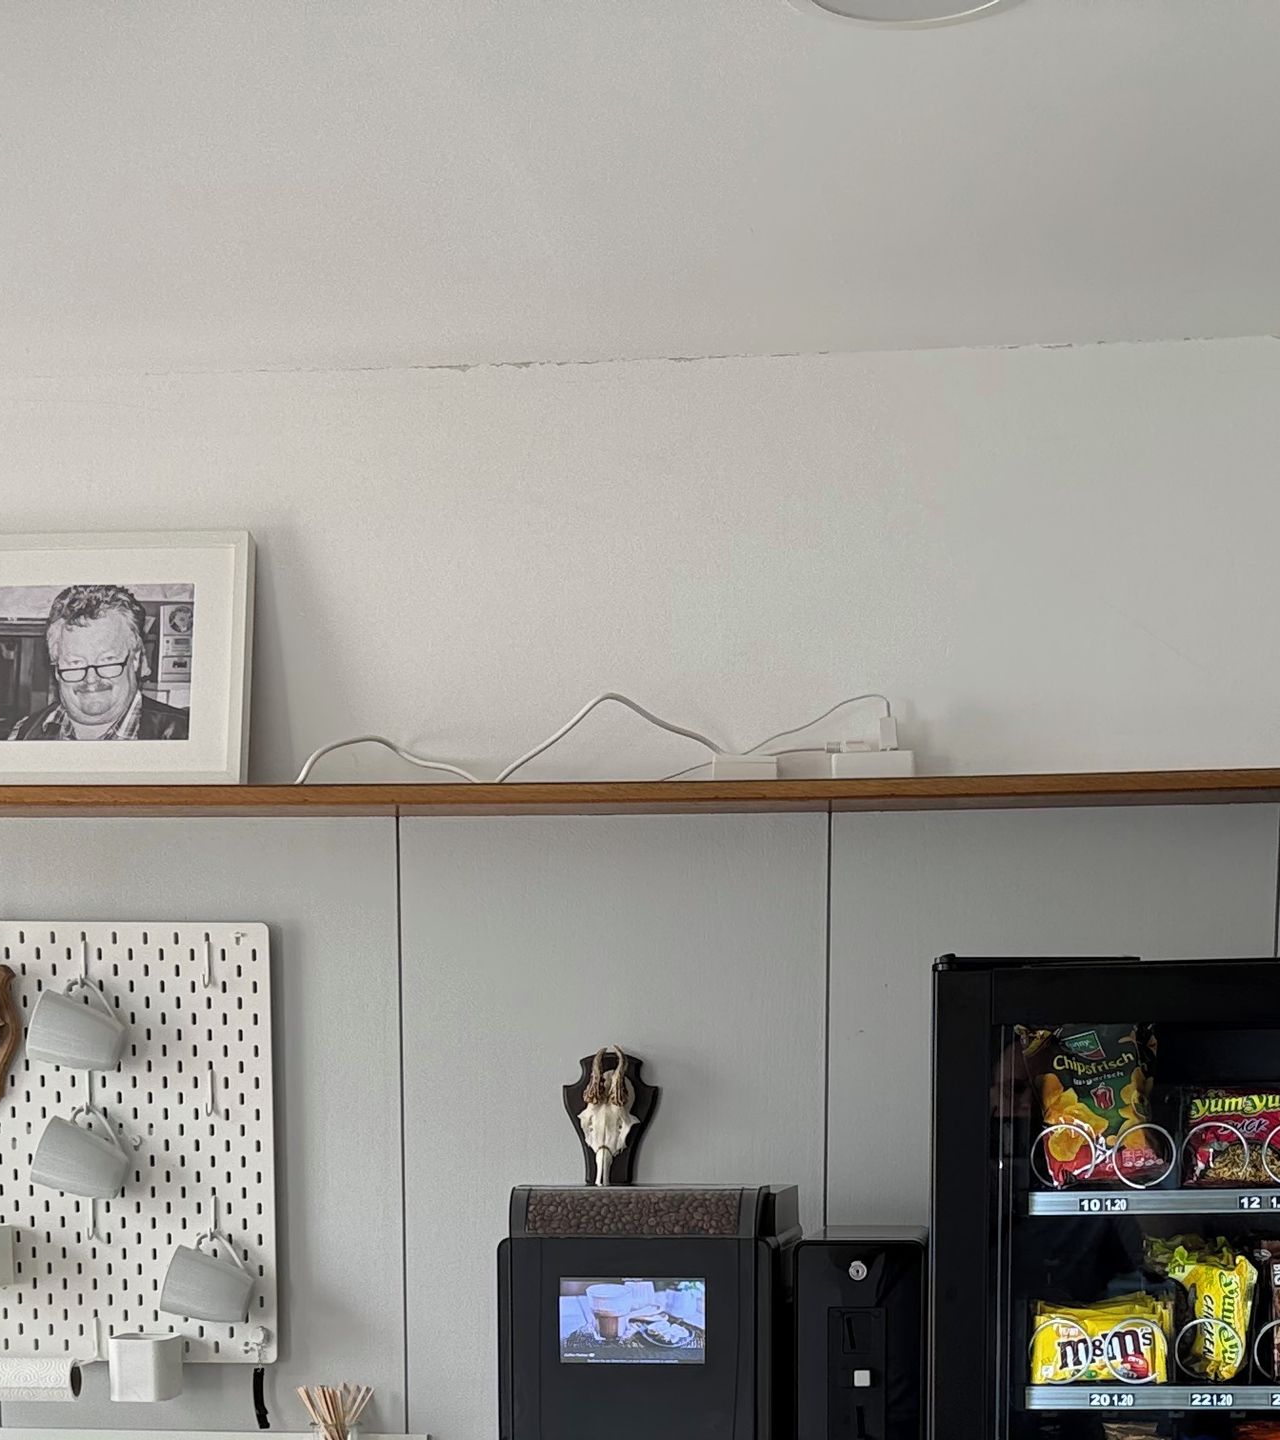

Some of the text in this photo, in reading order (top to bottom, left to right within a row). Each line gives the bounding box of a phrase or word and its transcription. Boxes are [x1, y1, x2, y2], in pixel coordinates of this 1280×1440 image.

[1053, 1052, 1135, 1076] Chipsfrisch
[1081, 1199, 1127, 1211] 10 1.20
[1240, 1197, 1261, 1208] 12
[1090, 1394, 1133, 1405] 20 1.20
[1191, 1394, 1233, 1406] 22 1.20
